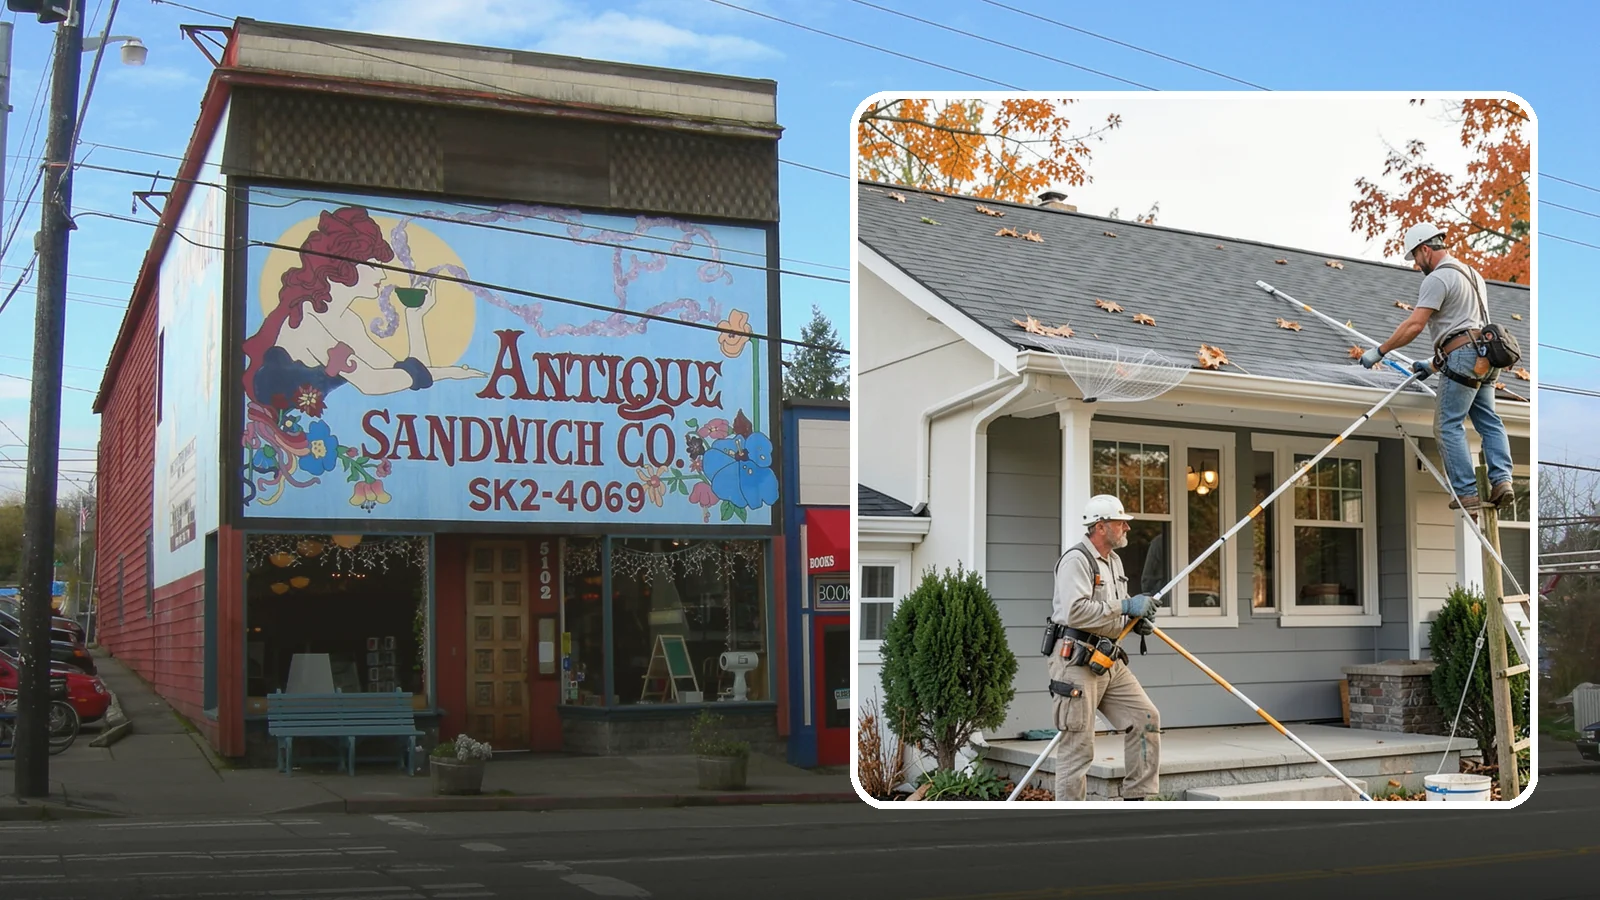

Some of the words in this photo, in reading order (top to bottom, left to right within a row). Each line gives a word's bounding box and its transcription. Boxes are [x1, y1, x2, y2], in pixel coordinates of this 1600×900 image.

[475, 329, 723, 420] ANTIQUE
[361, 409, 604, 466] SANDWICH
[617, 422, 684, 468] CO.
[468, 477, 645, 513] SK2-4069
[540, 542, 552, 599] 5102
[809, 555, 835, 569] BOOKS
